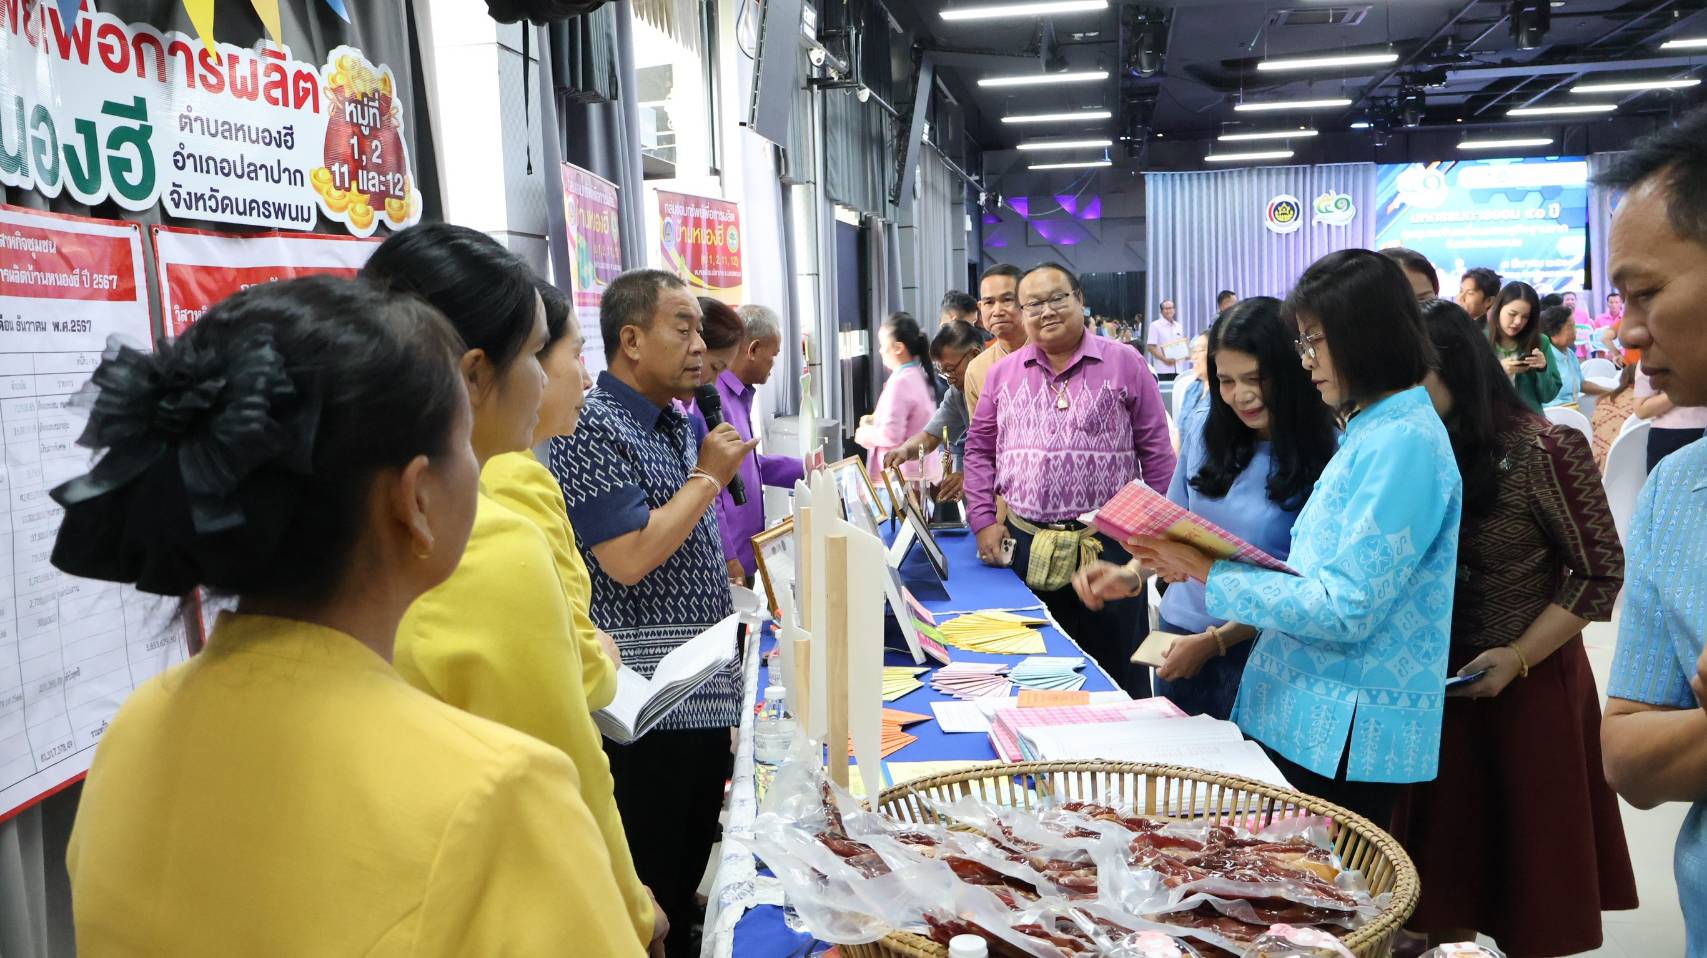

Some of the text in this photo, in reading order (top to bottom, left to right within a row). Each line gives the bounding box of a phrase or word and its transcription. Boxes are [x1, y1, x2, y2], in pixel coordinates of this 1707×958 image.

[178, 104, 295, 151] ตำบลหนองฮี
[345, 91, 381, 136] หมู่ที่
[172, 141, 305, 188] อำเภอปลาปาก
[169, 181, 312, 223] จังหวัดนครพนม
[93, 273, 118, 290] 2567
[15, 314, 47, 333] ธันวาคม
[52, 319, 93, 333] พ.ศ.2567
